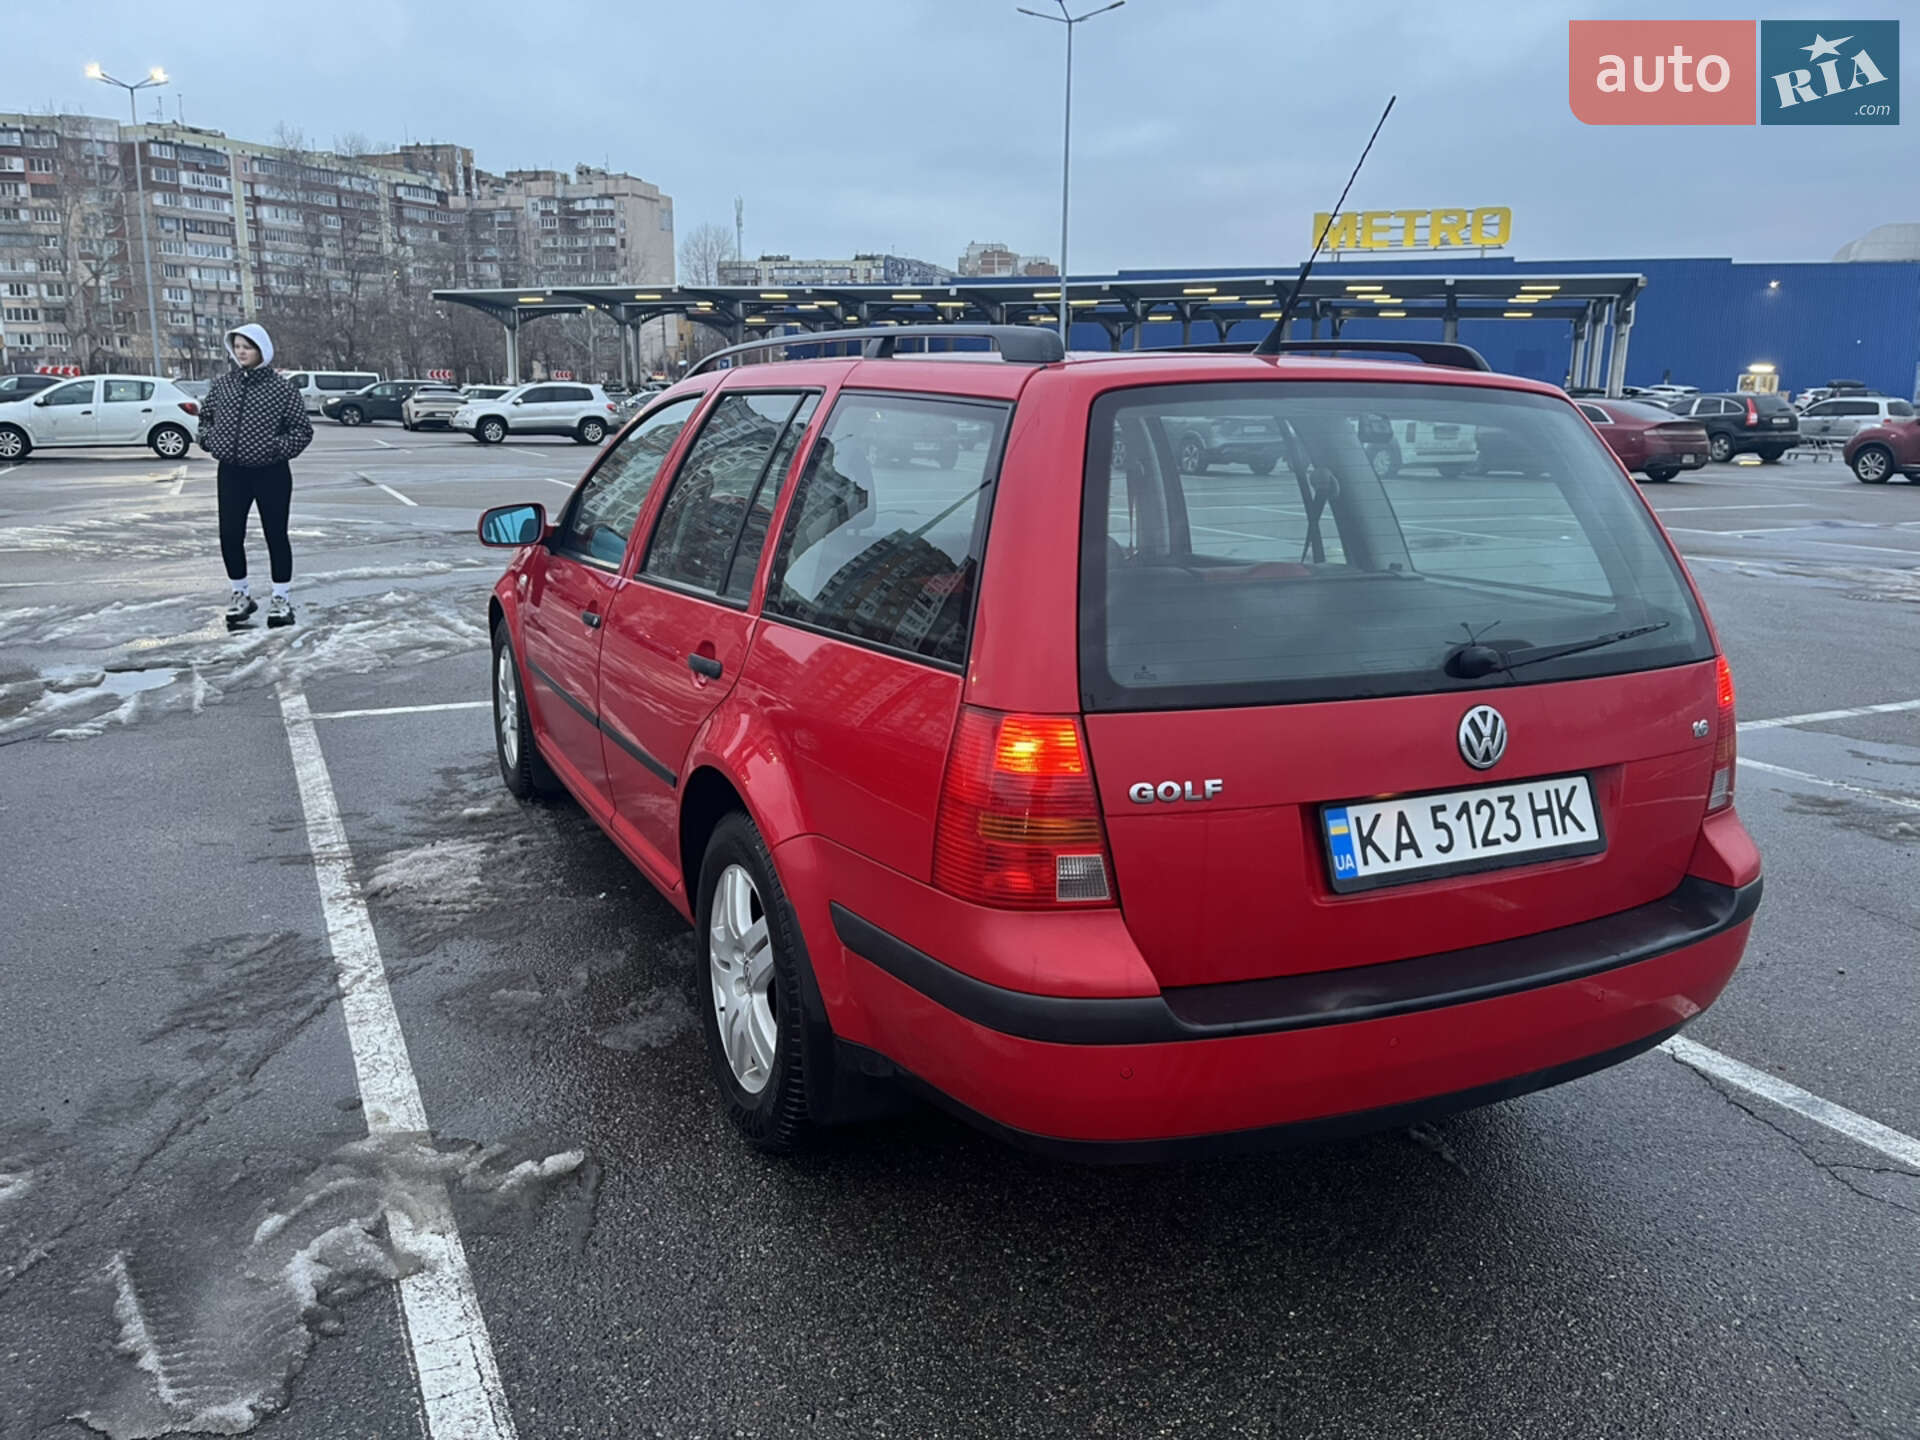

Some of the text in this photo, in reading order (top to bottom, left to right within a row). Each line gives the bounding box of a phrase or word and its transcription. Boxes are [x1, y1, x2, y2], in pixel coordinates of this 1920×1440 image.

[1312, 206, 1512, 249] METRO
[1128, 778, 1223, 803] GOLF
[1355, 785, 1586, 866] KA 5123 HK
[1334, 855, 1355, 871] UA
